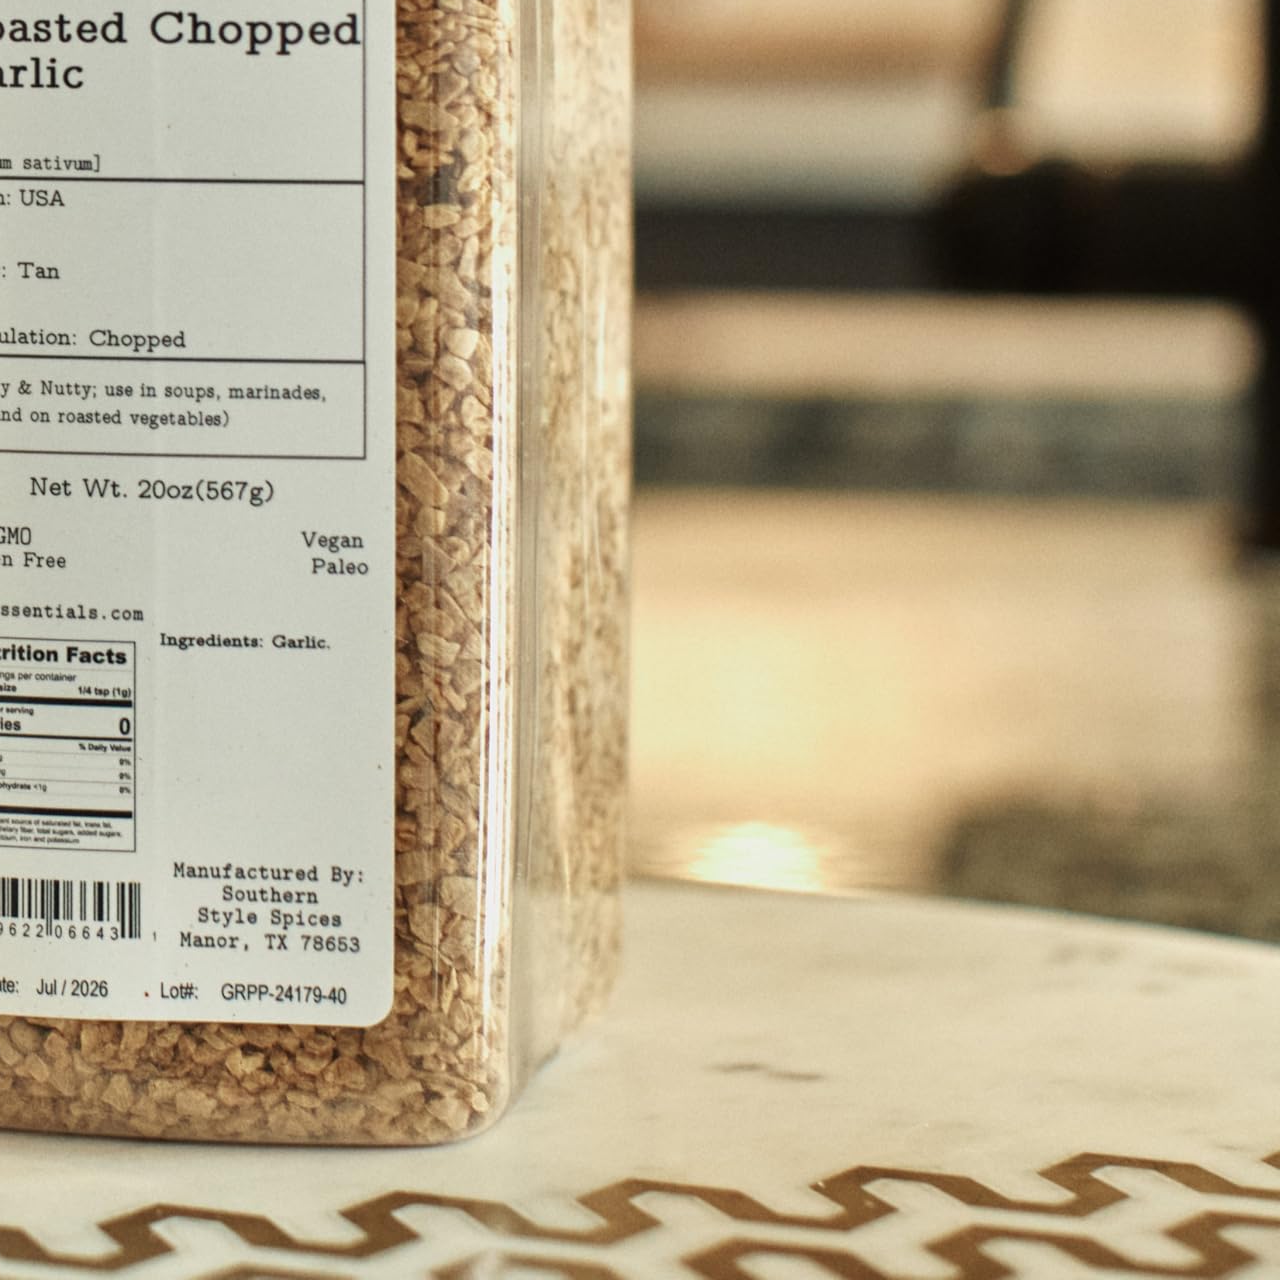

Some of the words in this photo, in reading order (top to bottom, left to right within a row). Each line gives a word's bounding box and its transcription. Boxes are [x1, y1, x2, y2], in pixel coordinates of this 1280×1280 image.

[150, 12, 360, 55] Chopped
[23, 154, 100, 172] sativum]
[20, 189, 64, 207] USA
[18, 262, 60, 279] Tan
[90, 329, 186, 352] Chopped
[18, 380, 32, 395] &
[41, 381, 97, 400] Nutty;
[105, 385, 133, 398] use
[140, 383, 156, 398] in
[164, 386, 220, 403] soups,
[229, 385, 326, 403] marinades,
[30, 411, 51, 423] on
[58, 409, 121, 425] roasted
[130, 410, 229, 428] vegetables)
[30, 478, 71, 497] Net
[83, 479, 127, 499] Wt.
[138, 480, 274, 506] 20oz(567g)
[301, 532, 364, 552] Vegan
[23, 552, 67, 568] Free
[311, 558, 368, 575] Paleo
[160, 633, 263, 650] Ingredients:
[272, 635, 330, 650] Garlic.
[67, 647, 126, 664] Facts
[18, 672, 32, 680] per
[35, 672, 76, 681] container
[0, 684, 16, 692] size
[78, 686, 91, 694] 1/4
[95, 688, 109, 696] tsp
[113, 688, 131, 697] (1g)
[119, 718, 130, 735] 0
[174, 862, 318, 882] Manufactured
[331, 866, 364, 886] By:
[222, 886, 318, 904] Southern
[198, 908, 257, 926] Style
[271, 909, 342, 930] Spices
[54, 926, 119, 940] 06643
[180, 931, 250, 952] Manor,
[264, 934, 288, 951] TX
[301, 936, 360, 954] 78653
[36, 979, 57, 996] Jul
[71, 980, 108, 998] 2026
[160, 982, 199, 1001] Lot#:
[221, 983, 347, 1005] GRPP-24179-40
